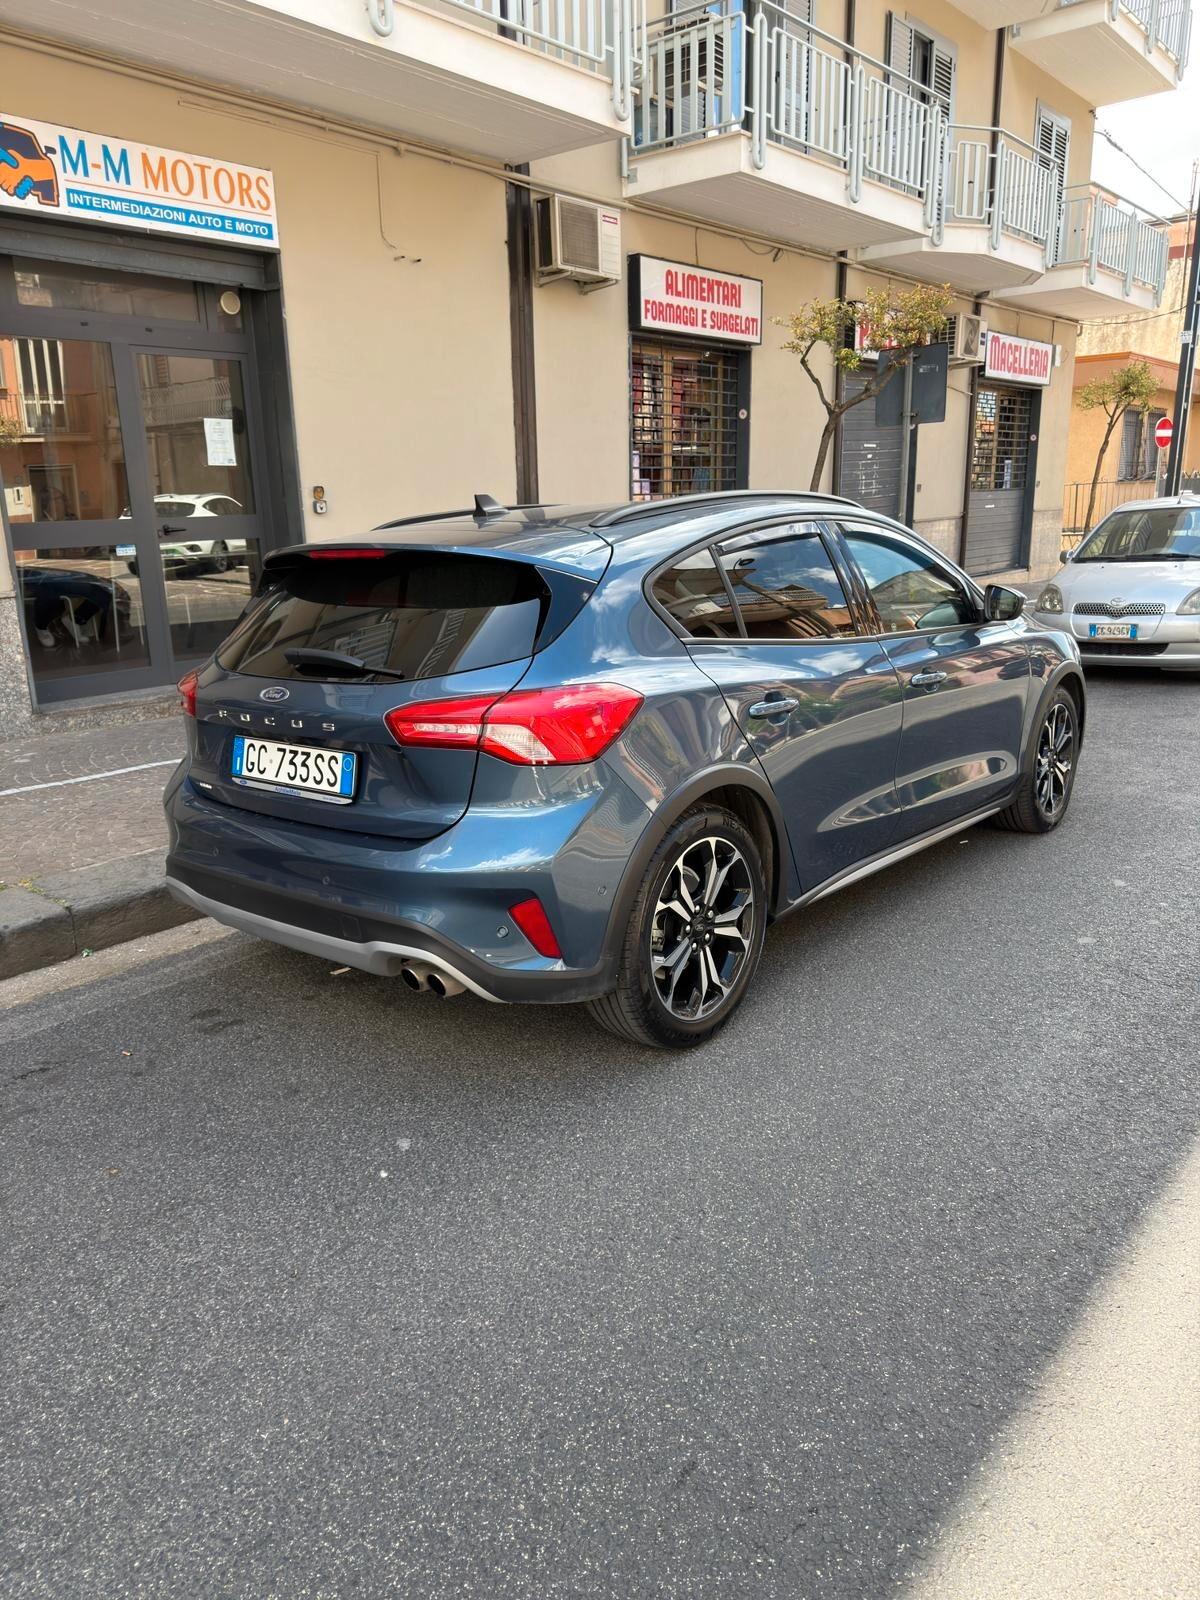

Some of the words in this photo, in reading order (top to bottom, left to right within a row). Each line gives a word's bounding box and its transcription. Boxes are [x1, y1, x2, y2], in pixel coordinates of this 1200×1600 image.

[58, 134, 132, 186] M-M
[140, 152, 271, 211] MOTORS
[69, 192, 186, 222] INTERMEDIAZIONI
[188, 212, 222, 229] AUTO
[224, 219, 233, 230] E
[235, 221, 269, 237] MOTO
[665, 269, 741, 309] ALIMENTARI
[644, 299, 698, 328] FORMAGGI
[701, 309, 707, 329] E
[709, 313, 759, 337] SURGELATI
[989, 335, 1048, 378] MACELLERIA
[218, 709, 335, 732] FOCUS
